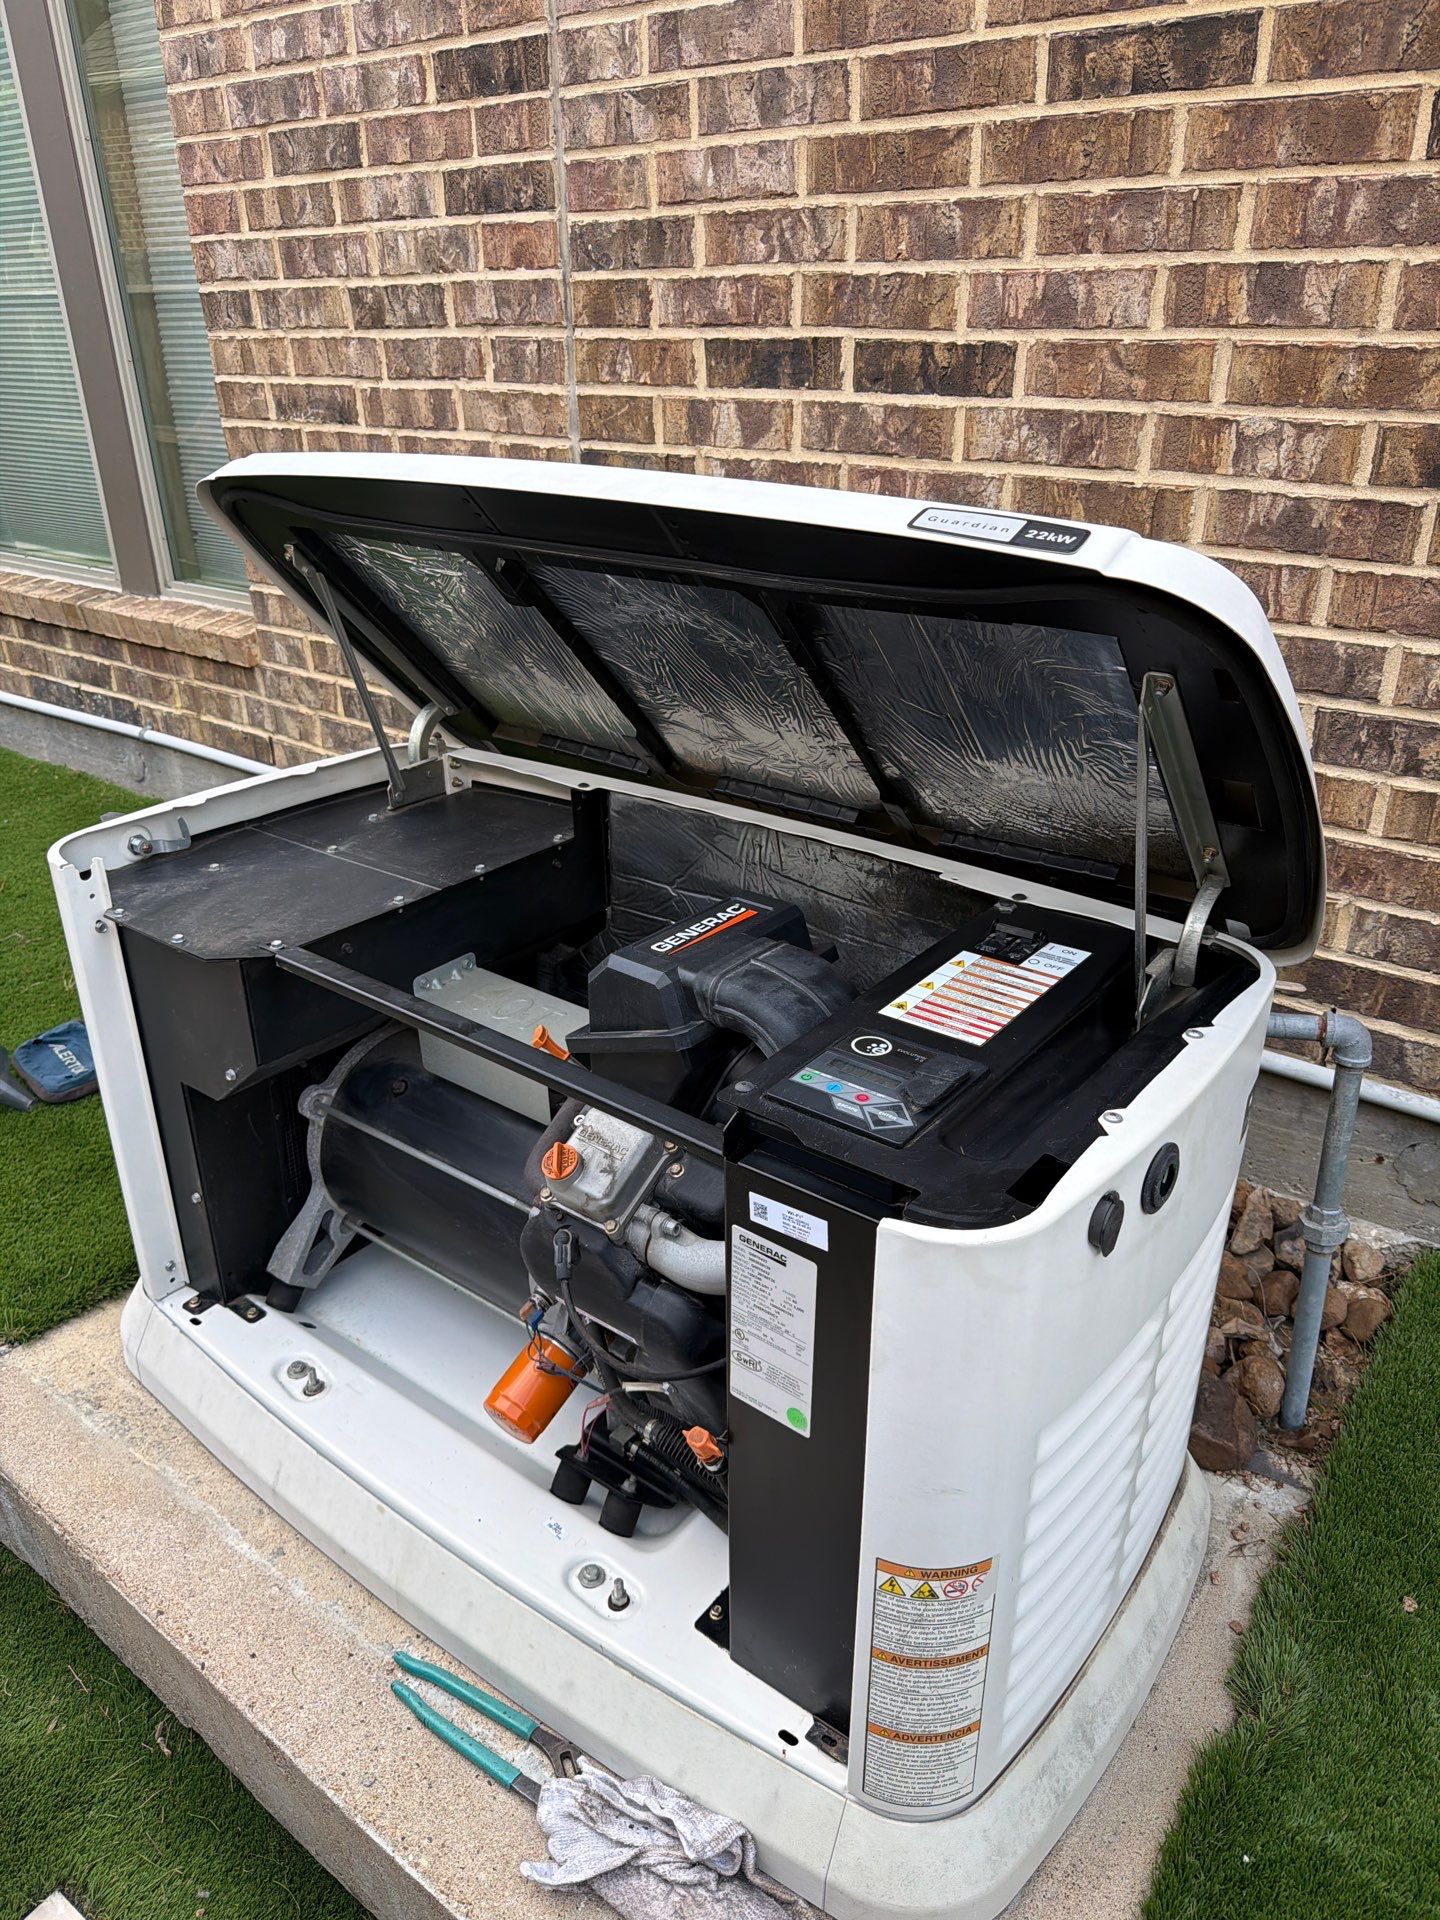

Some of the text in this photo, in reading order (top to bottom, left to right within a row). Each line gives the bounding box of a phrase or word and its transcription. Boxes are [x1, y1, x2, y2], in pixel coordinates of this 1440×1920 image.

[928, 515, 1077, 544] Guardian 22kW
[650, 903, 747, 952] GENERAC
[1043, 962, 1065, 972] OFF
[836, 1102, 859, 1113] ESCAPE
[878, 1111, 897, 1121] ENTER
[579, 1127, 630, 1156] GENERAC
[738, 1234, 788, 1263] GENERAC
[920, 1565, 978, 1580] WARNING
[890, 1646, 985, 1667] AVERTISSEMENT
[893, 1727, 972, 1742] ADVERTENCIA
